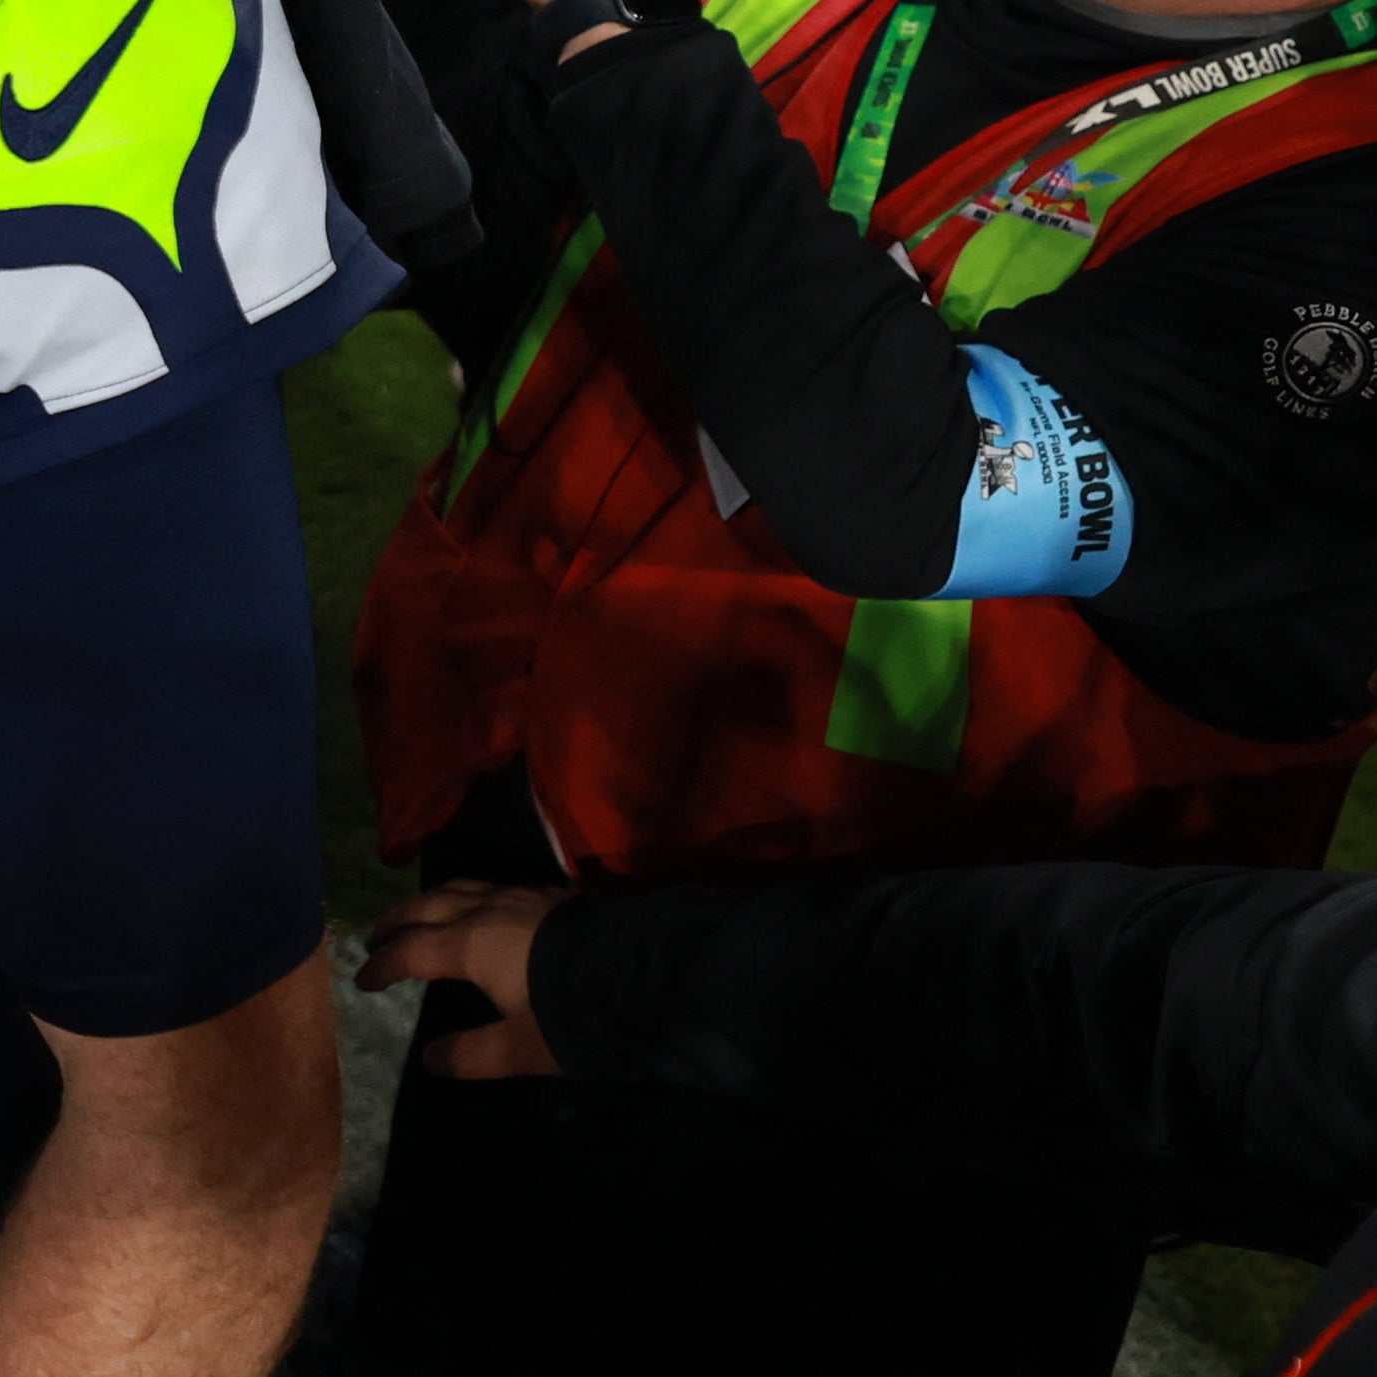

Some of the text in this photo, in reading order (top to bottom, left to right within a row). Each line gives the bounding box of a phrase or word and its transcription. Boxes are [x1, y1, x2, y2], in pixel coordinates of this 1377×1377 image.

[1066, 36, 1302, 135] SUPER BOWL LX
[1293, 303, 1376, 335] PEBBLE
[1262, 337, 1280, 386] GOLF
[1030, 417, 1042, 439] NFL
[1276, 390, 1330, 420] LINKS
[1049, 434, 1067, 467] Field
[1058, 470, 1070, 520] Access
[1071, 452, 1114, 562] BOWL
